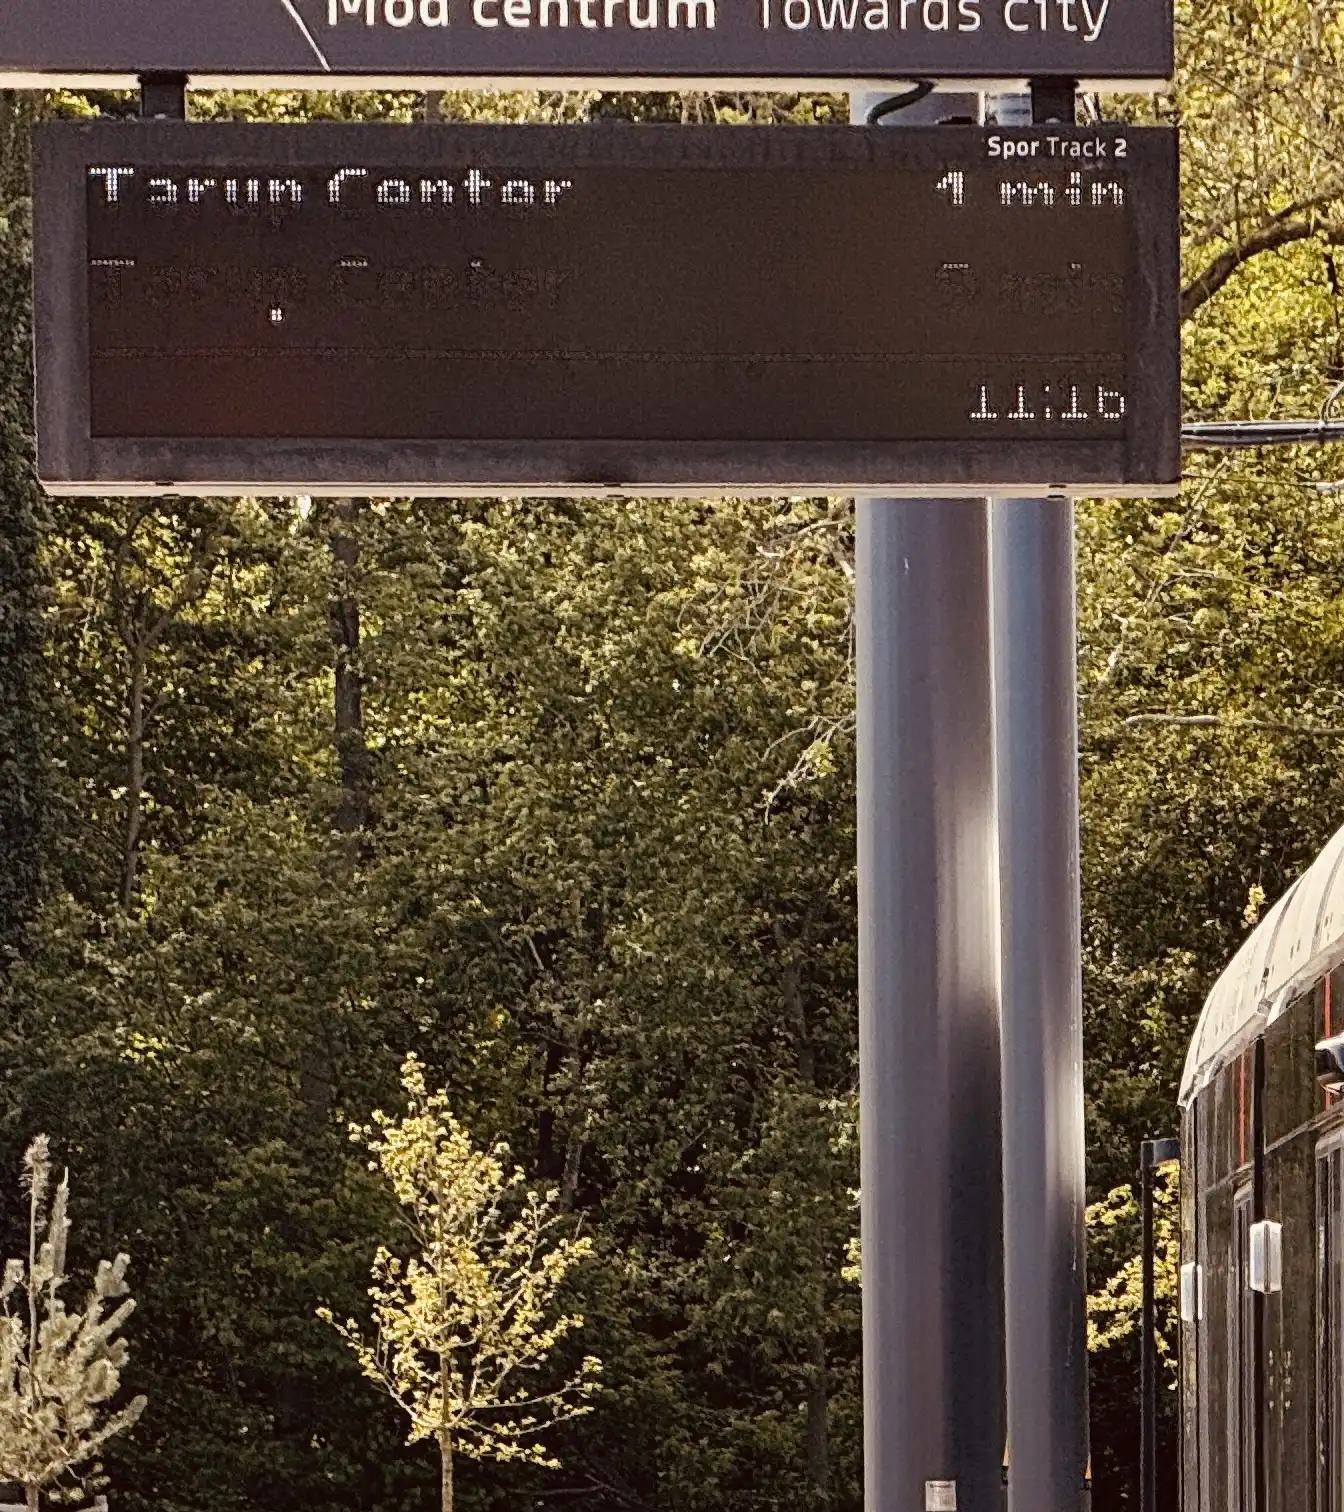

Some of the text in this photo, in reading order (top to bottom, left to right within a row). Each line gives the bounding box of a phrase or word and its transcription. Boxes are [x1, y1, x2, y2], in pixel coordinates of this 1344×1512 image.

[473, 0, 716, 29] centrum
[761, 0, 981, 31] Towards
[1004, 0, 1109, 41] city
[988, 136, 1128, 160] Spor Track 2
[1000, 171, 1124, 206] min
